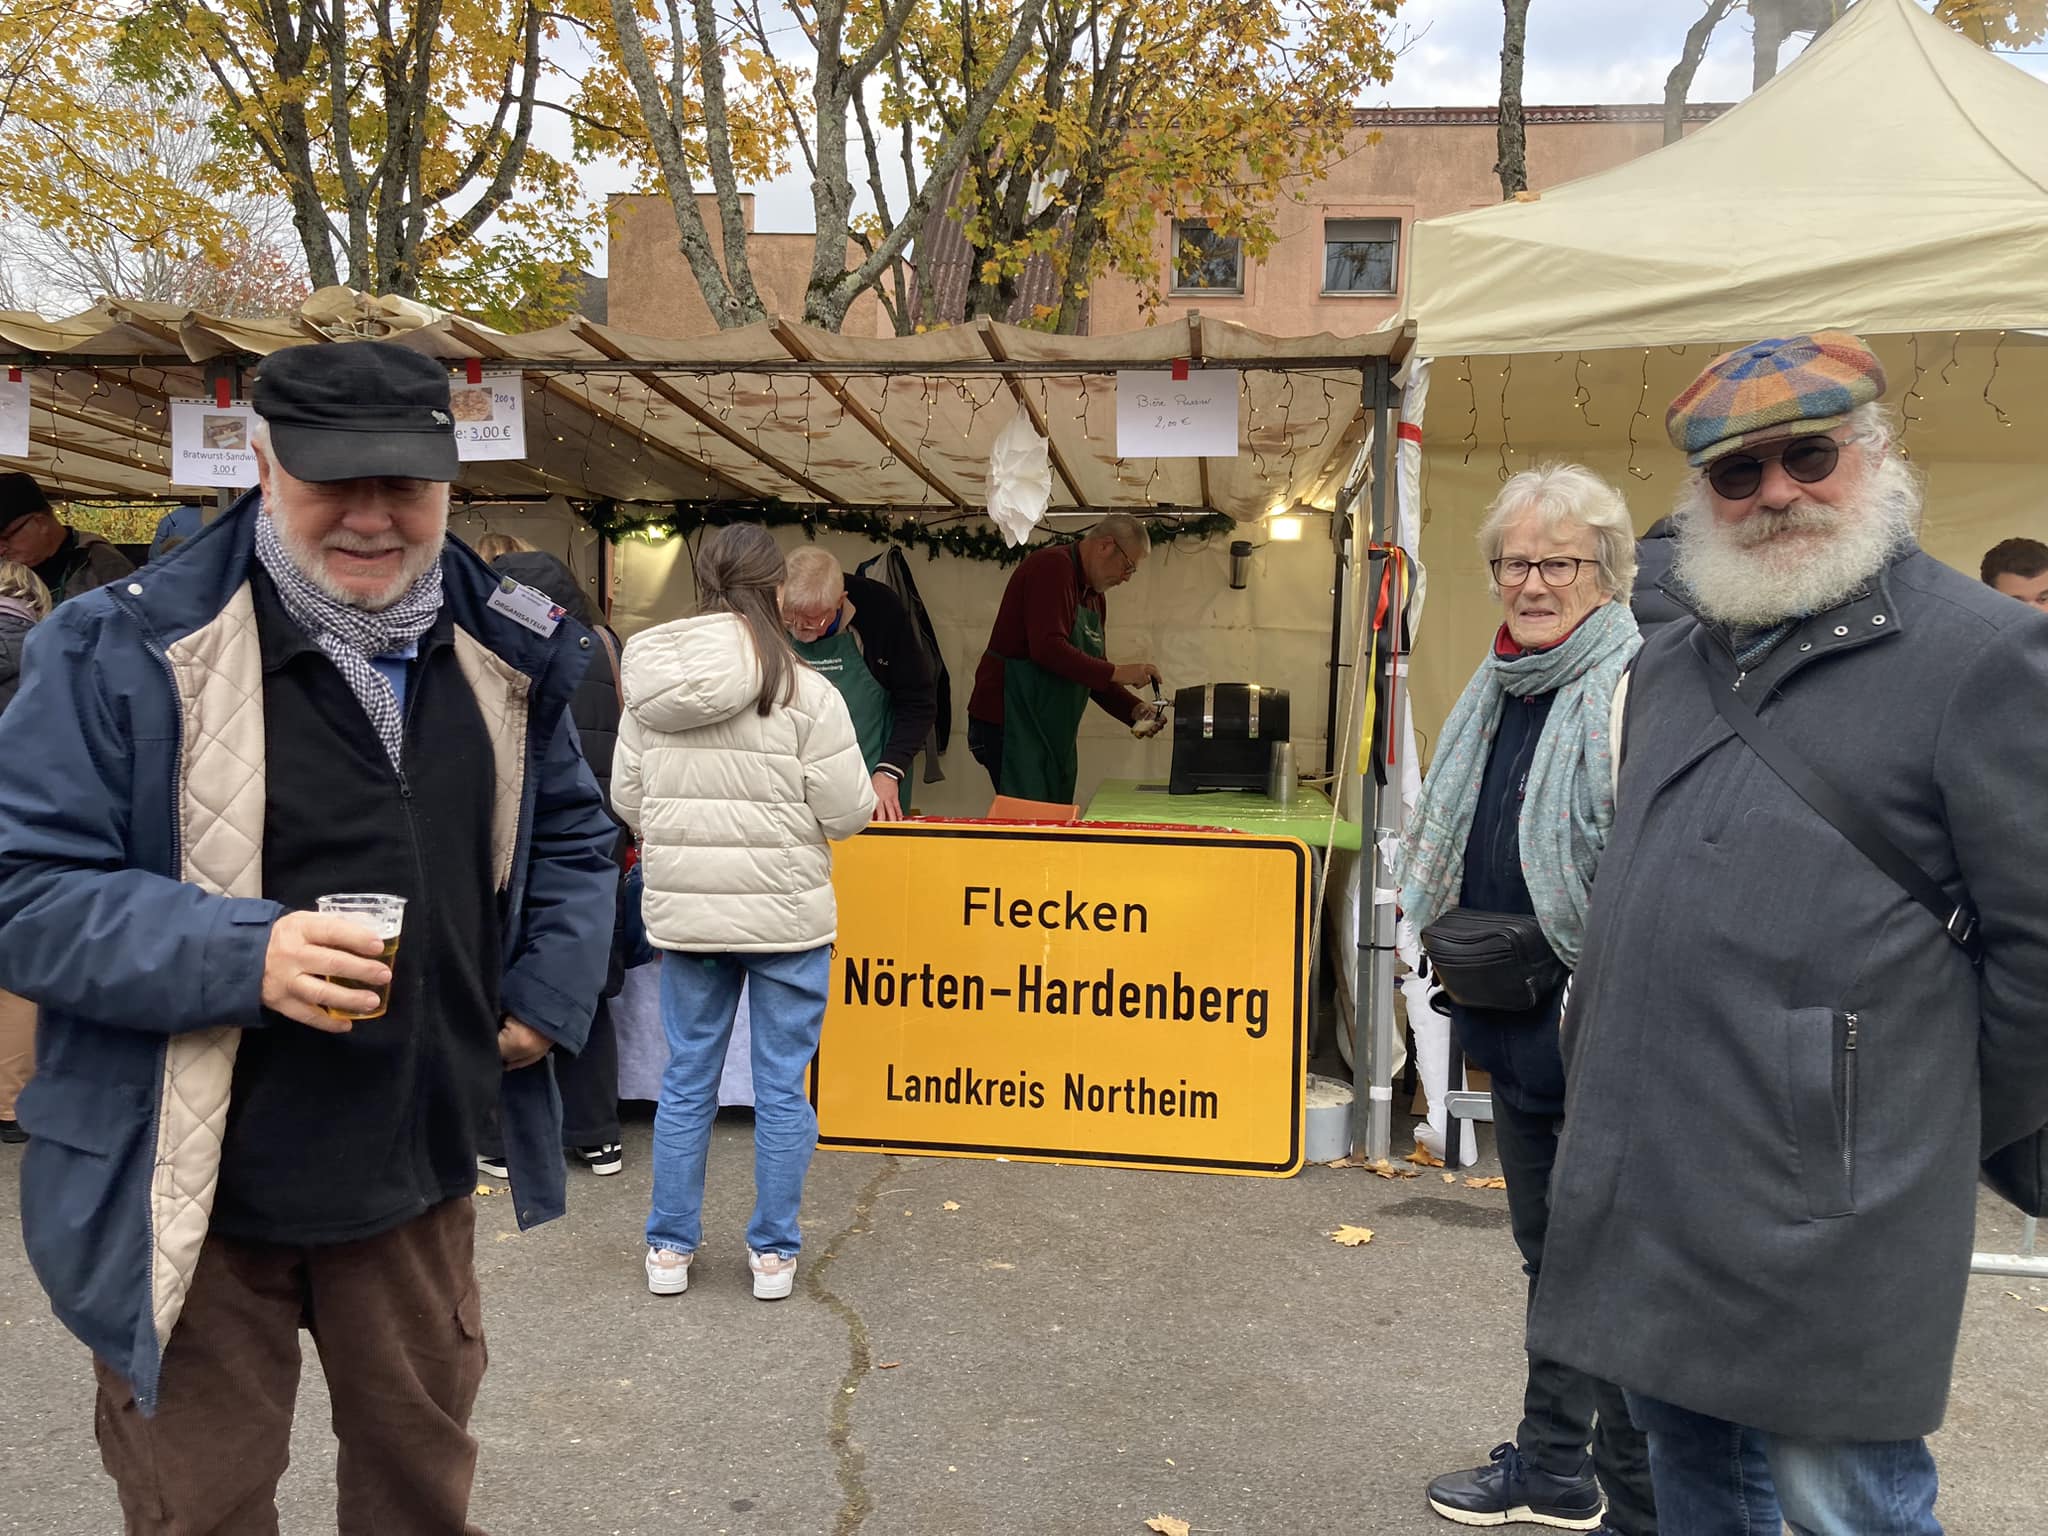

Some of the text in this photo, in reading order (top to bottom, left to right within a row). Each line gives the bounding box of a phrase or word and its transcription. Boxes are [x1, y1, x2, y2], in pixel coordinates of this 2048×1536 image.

[471, 426, 499, 440] 3,00
[503, 425, 512, 438] €
[183, 449, 257, 461] Bratwurst-Sandwic
[212, 464, 231, 476] 3,00
[494, 599, 548, 632] ORGANISATEUR
[964, 886, 1147, 933] Flecken
[844, 957, 1268, 1039] Nörten-Hardenberg
[887, 1063, 1218, 1119] Landkreis Northeim
